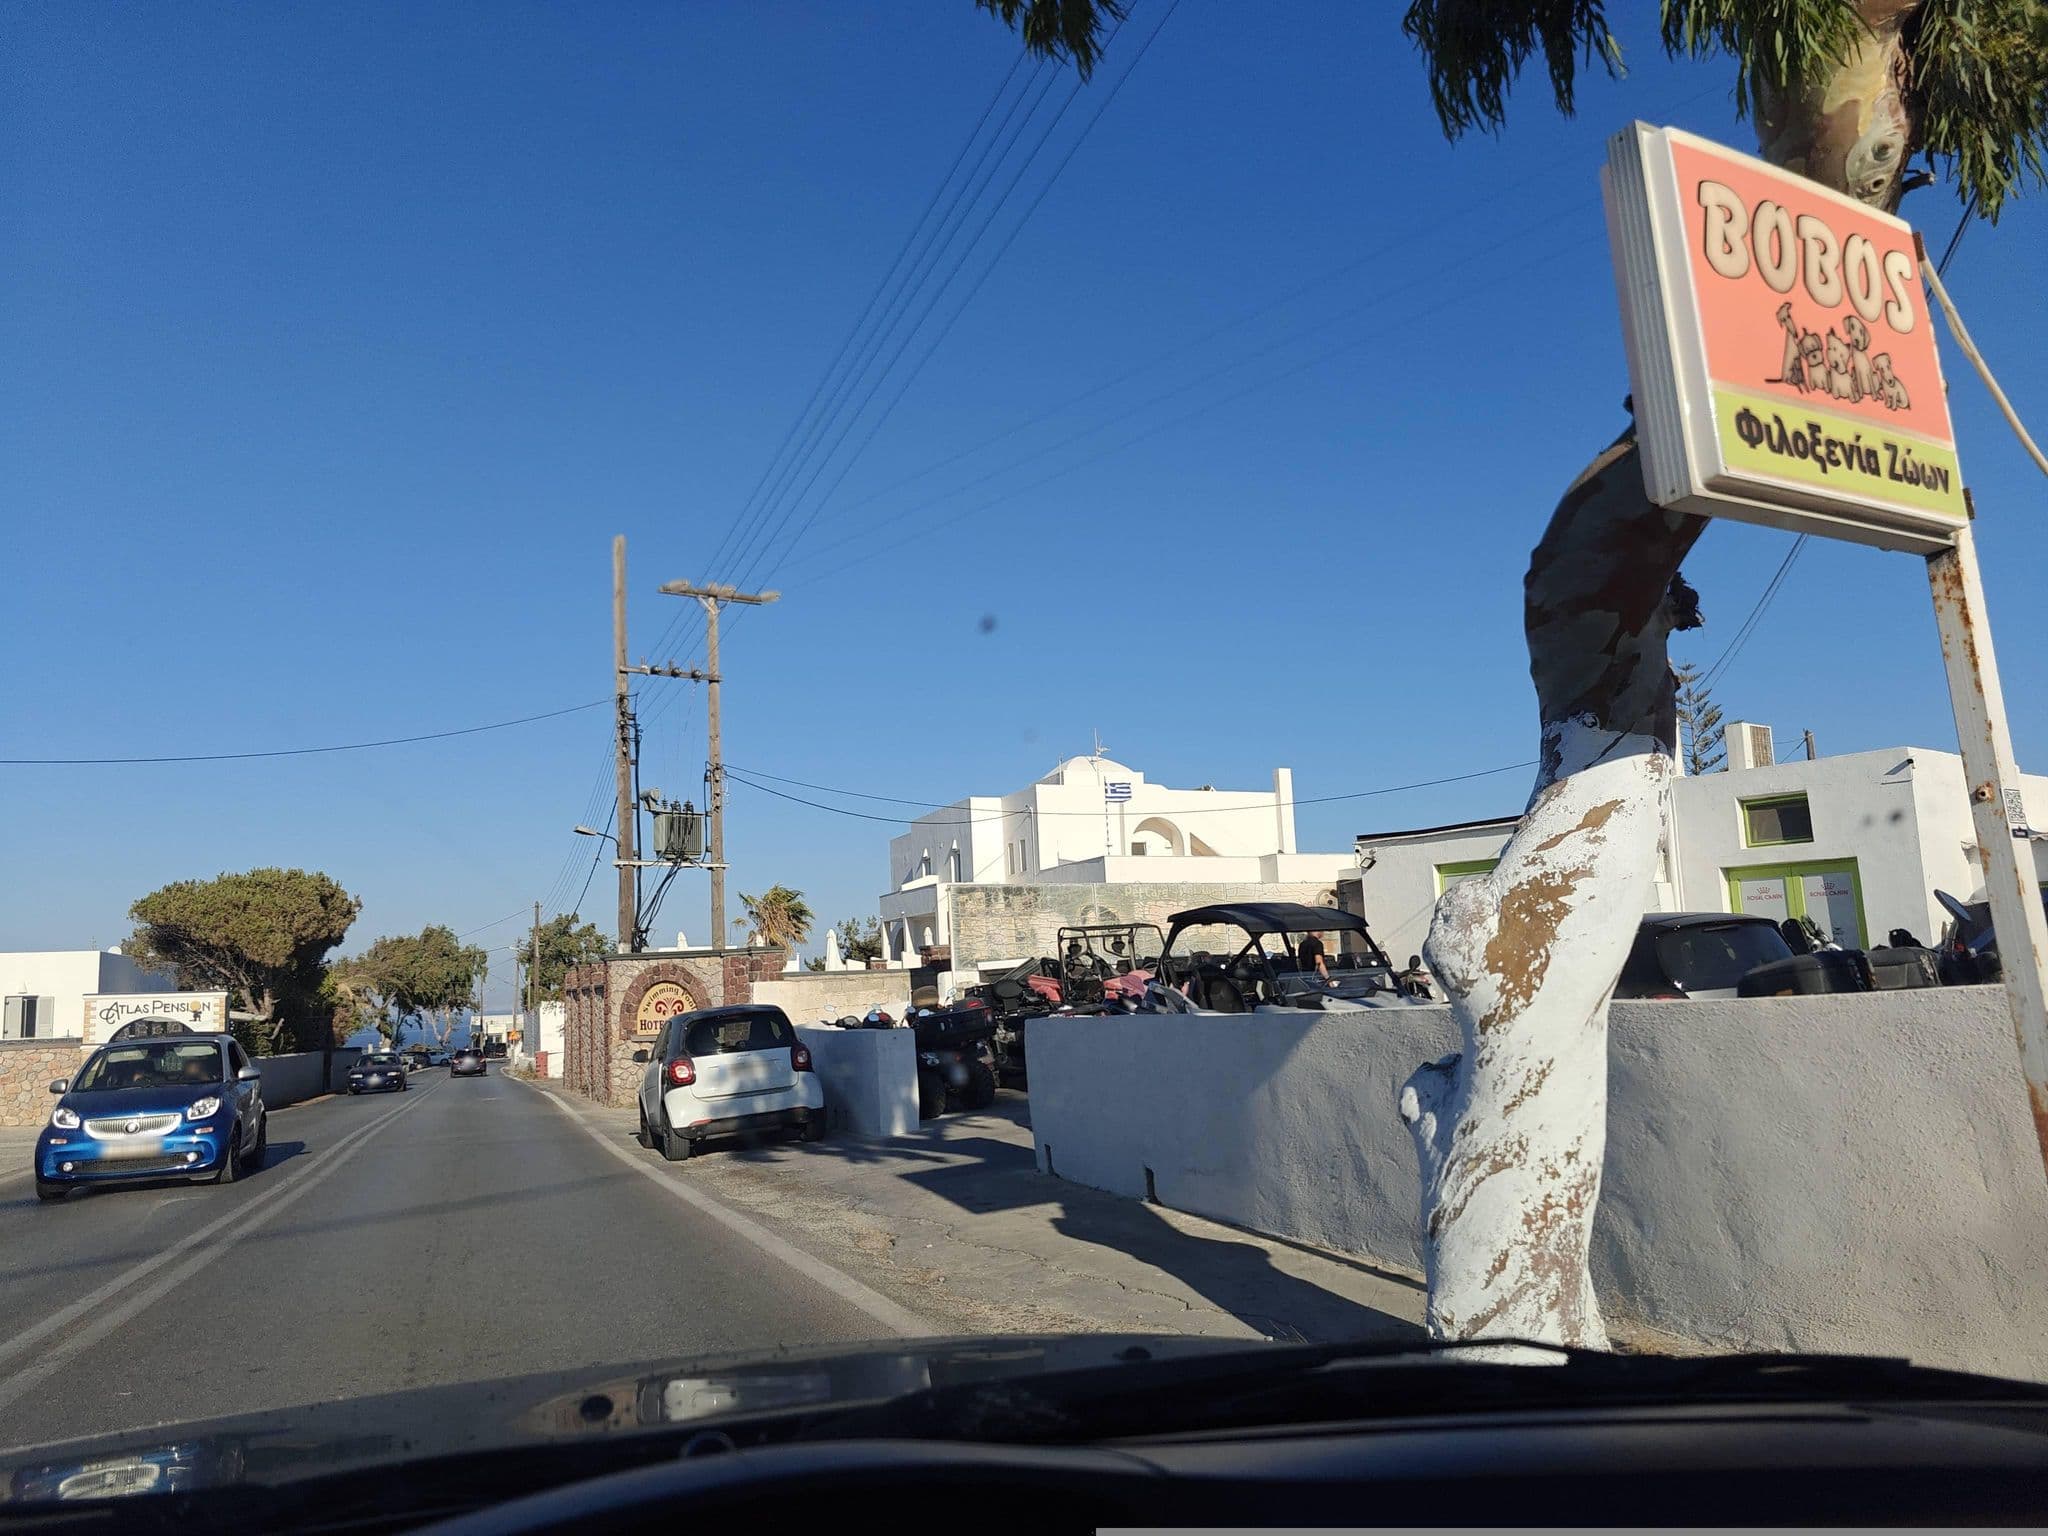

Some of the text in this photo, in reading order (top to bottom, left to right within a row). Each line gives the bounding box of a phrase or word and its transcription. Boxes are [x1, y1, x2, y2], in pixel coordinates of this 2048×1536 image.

[1697, 180, 1915, 334] BOBOS
[1734, 407, 1950, 494] Φιλοξενία Ζώων
[640, 1019, 665, 1031] HOTE
